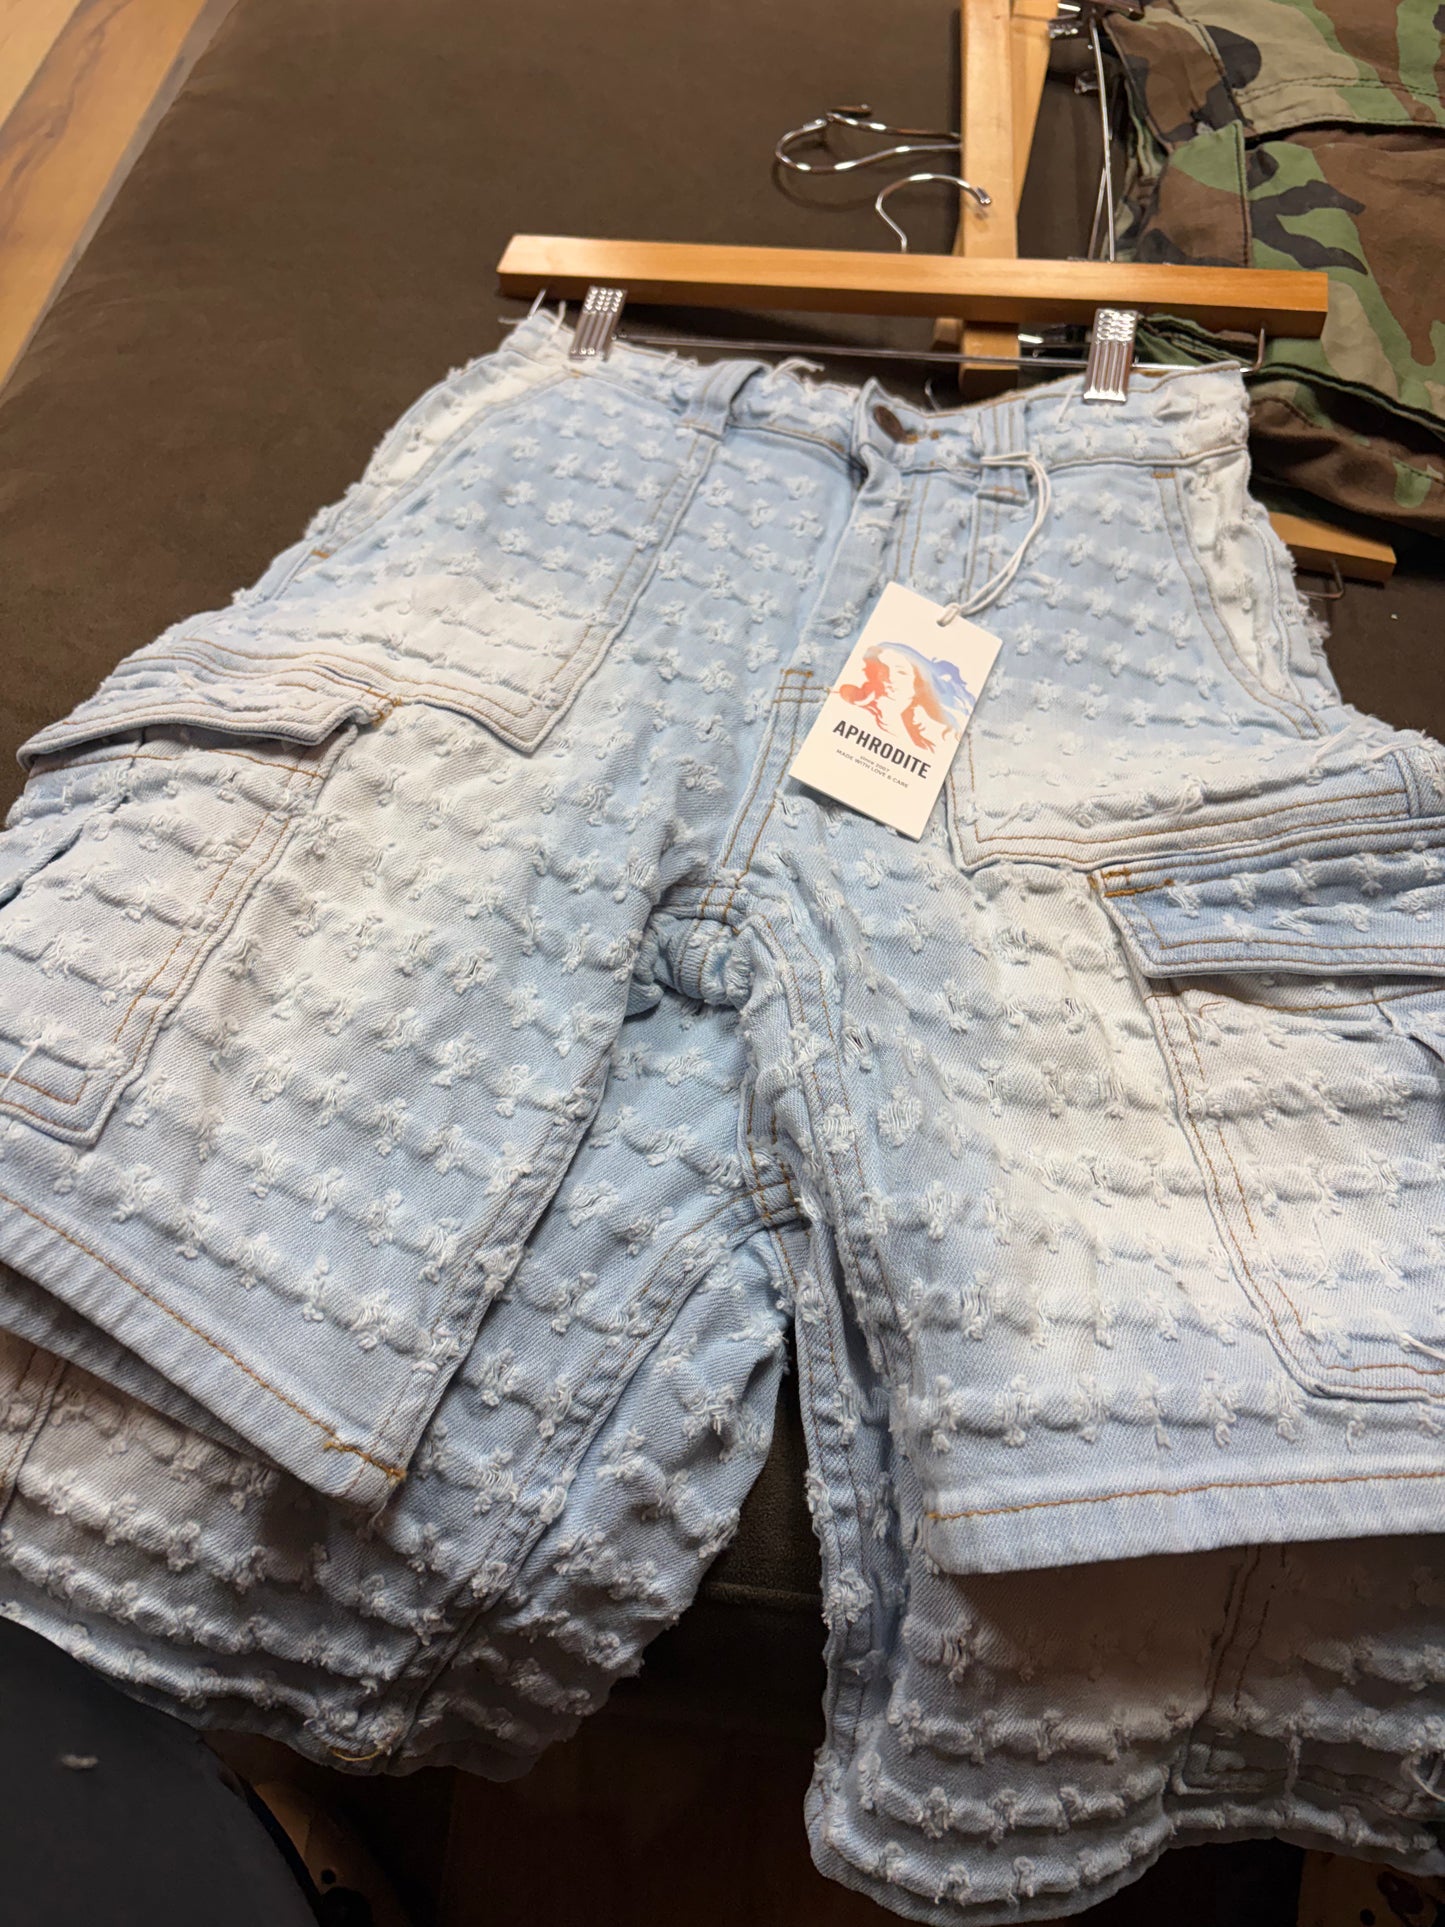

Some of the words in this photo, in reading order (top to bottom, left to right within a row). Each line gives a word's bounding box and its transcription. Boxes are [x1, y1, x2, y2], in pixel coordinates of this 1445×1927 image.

[832, 720, 931, 779] APHRODITE
[836, 749, 854, 760] MADE
[854, 758, 870, 769] WITH
[870, 766, 886, 777] LOVE
[892, 778, 908, 788] CARE
[860, 755, 875, 766] since
